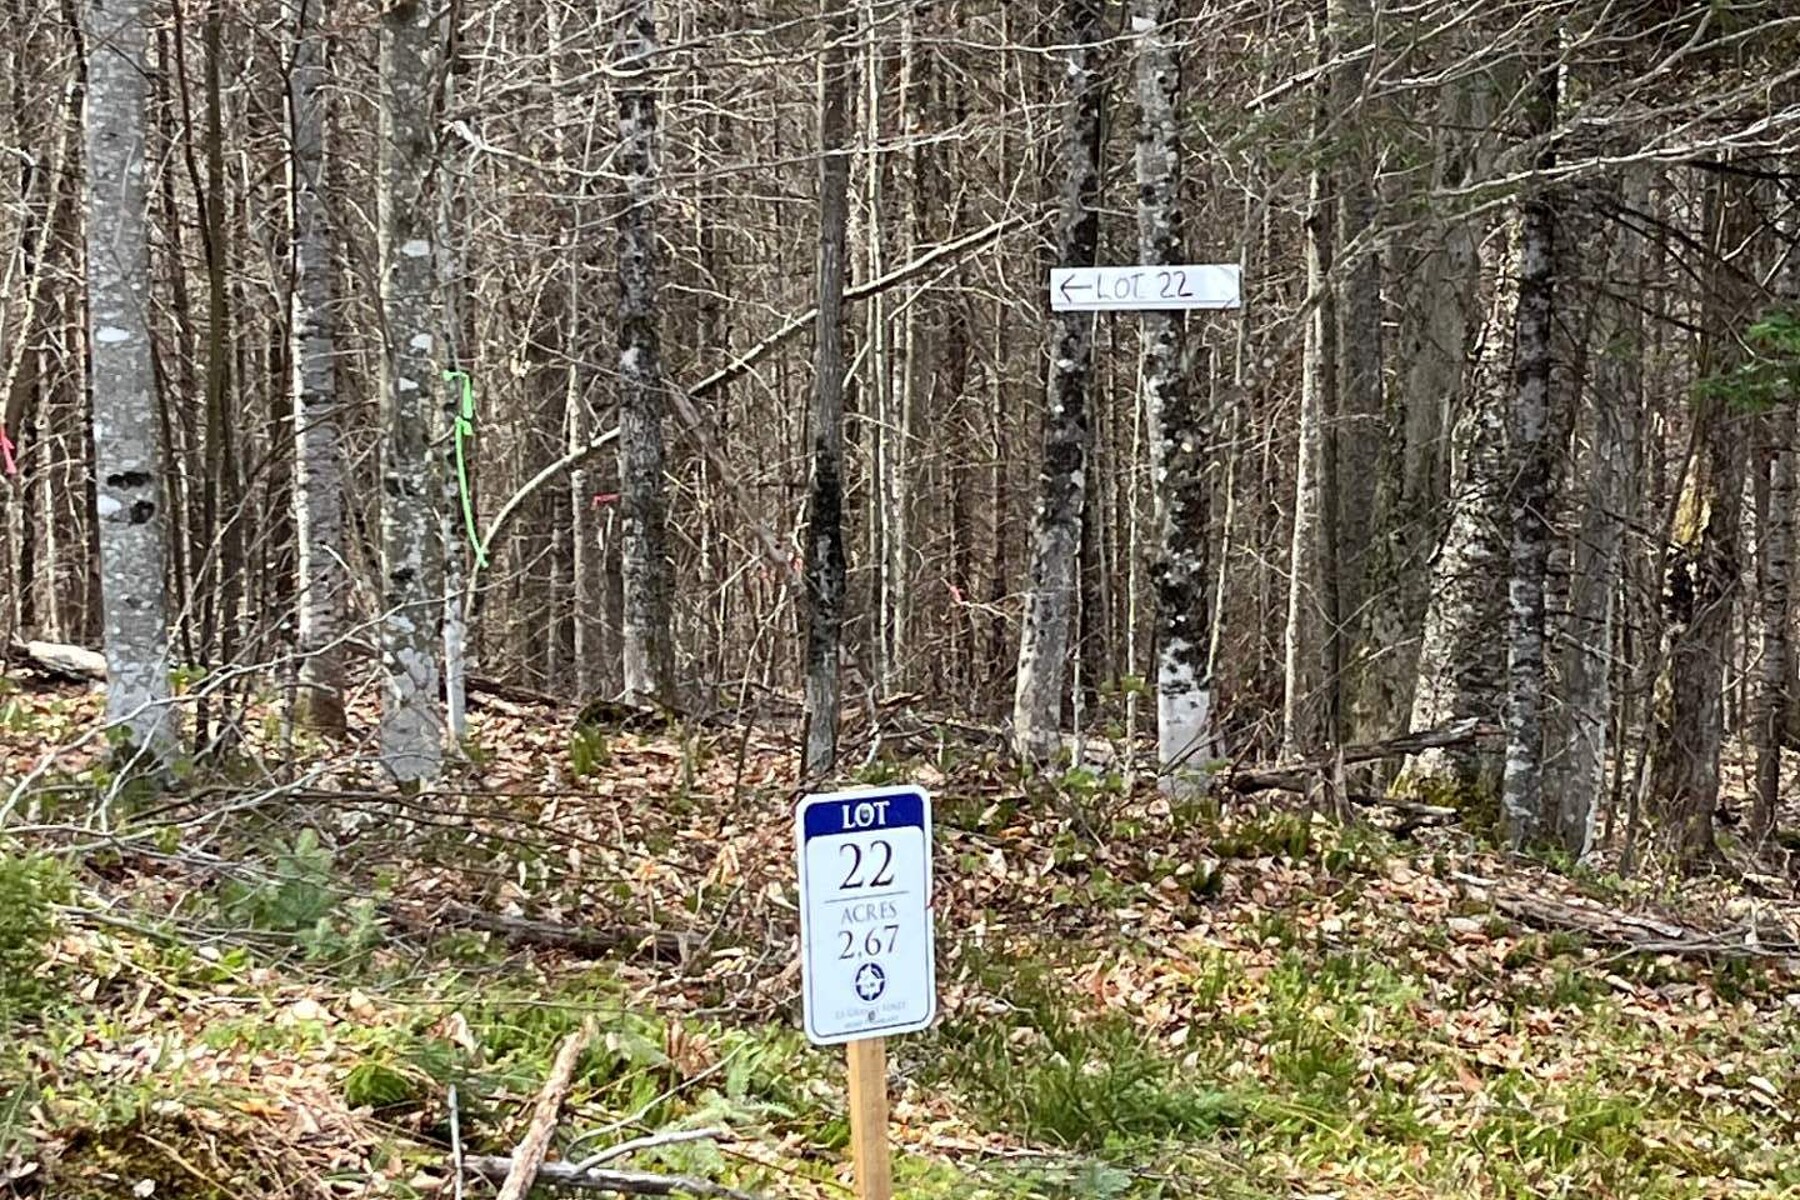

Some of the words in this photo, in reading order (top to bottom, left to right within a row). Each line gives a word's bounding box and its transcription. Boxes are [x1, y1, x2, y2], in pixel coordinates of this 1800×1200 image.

[1097, 273, 1145, 299] LOT
[1158, 270, 1193, 299] 22
[842, 801, 890, 828] LOT
[839, 840, 894, 890] 22
[841, 901, 897, 924] ACRES
[838, 924, 899, 960] 2.67
